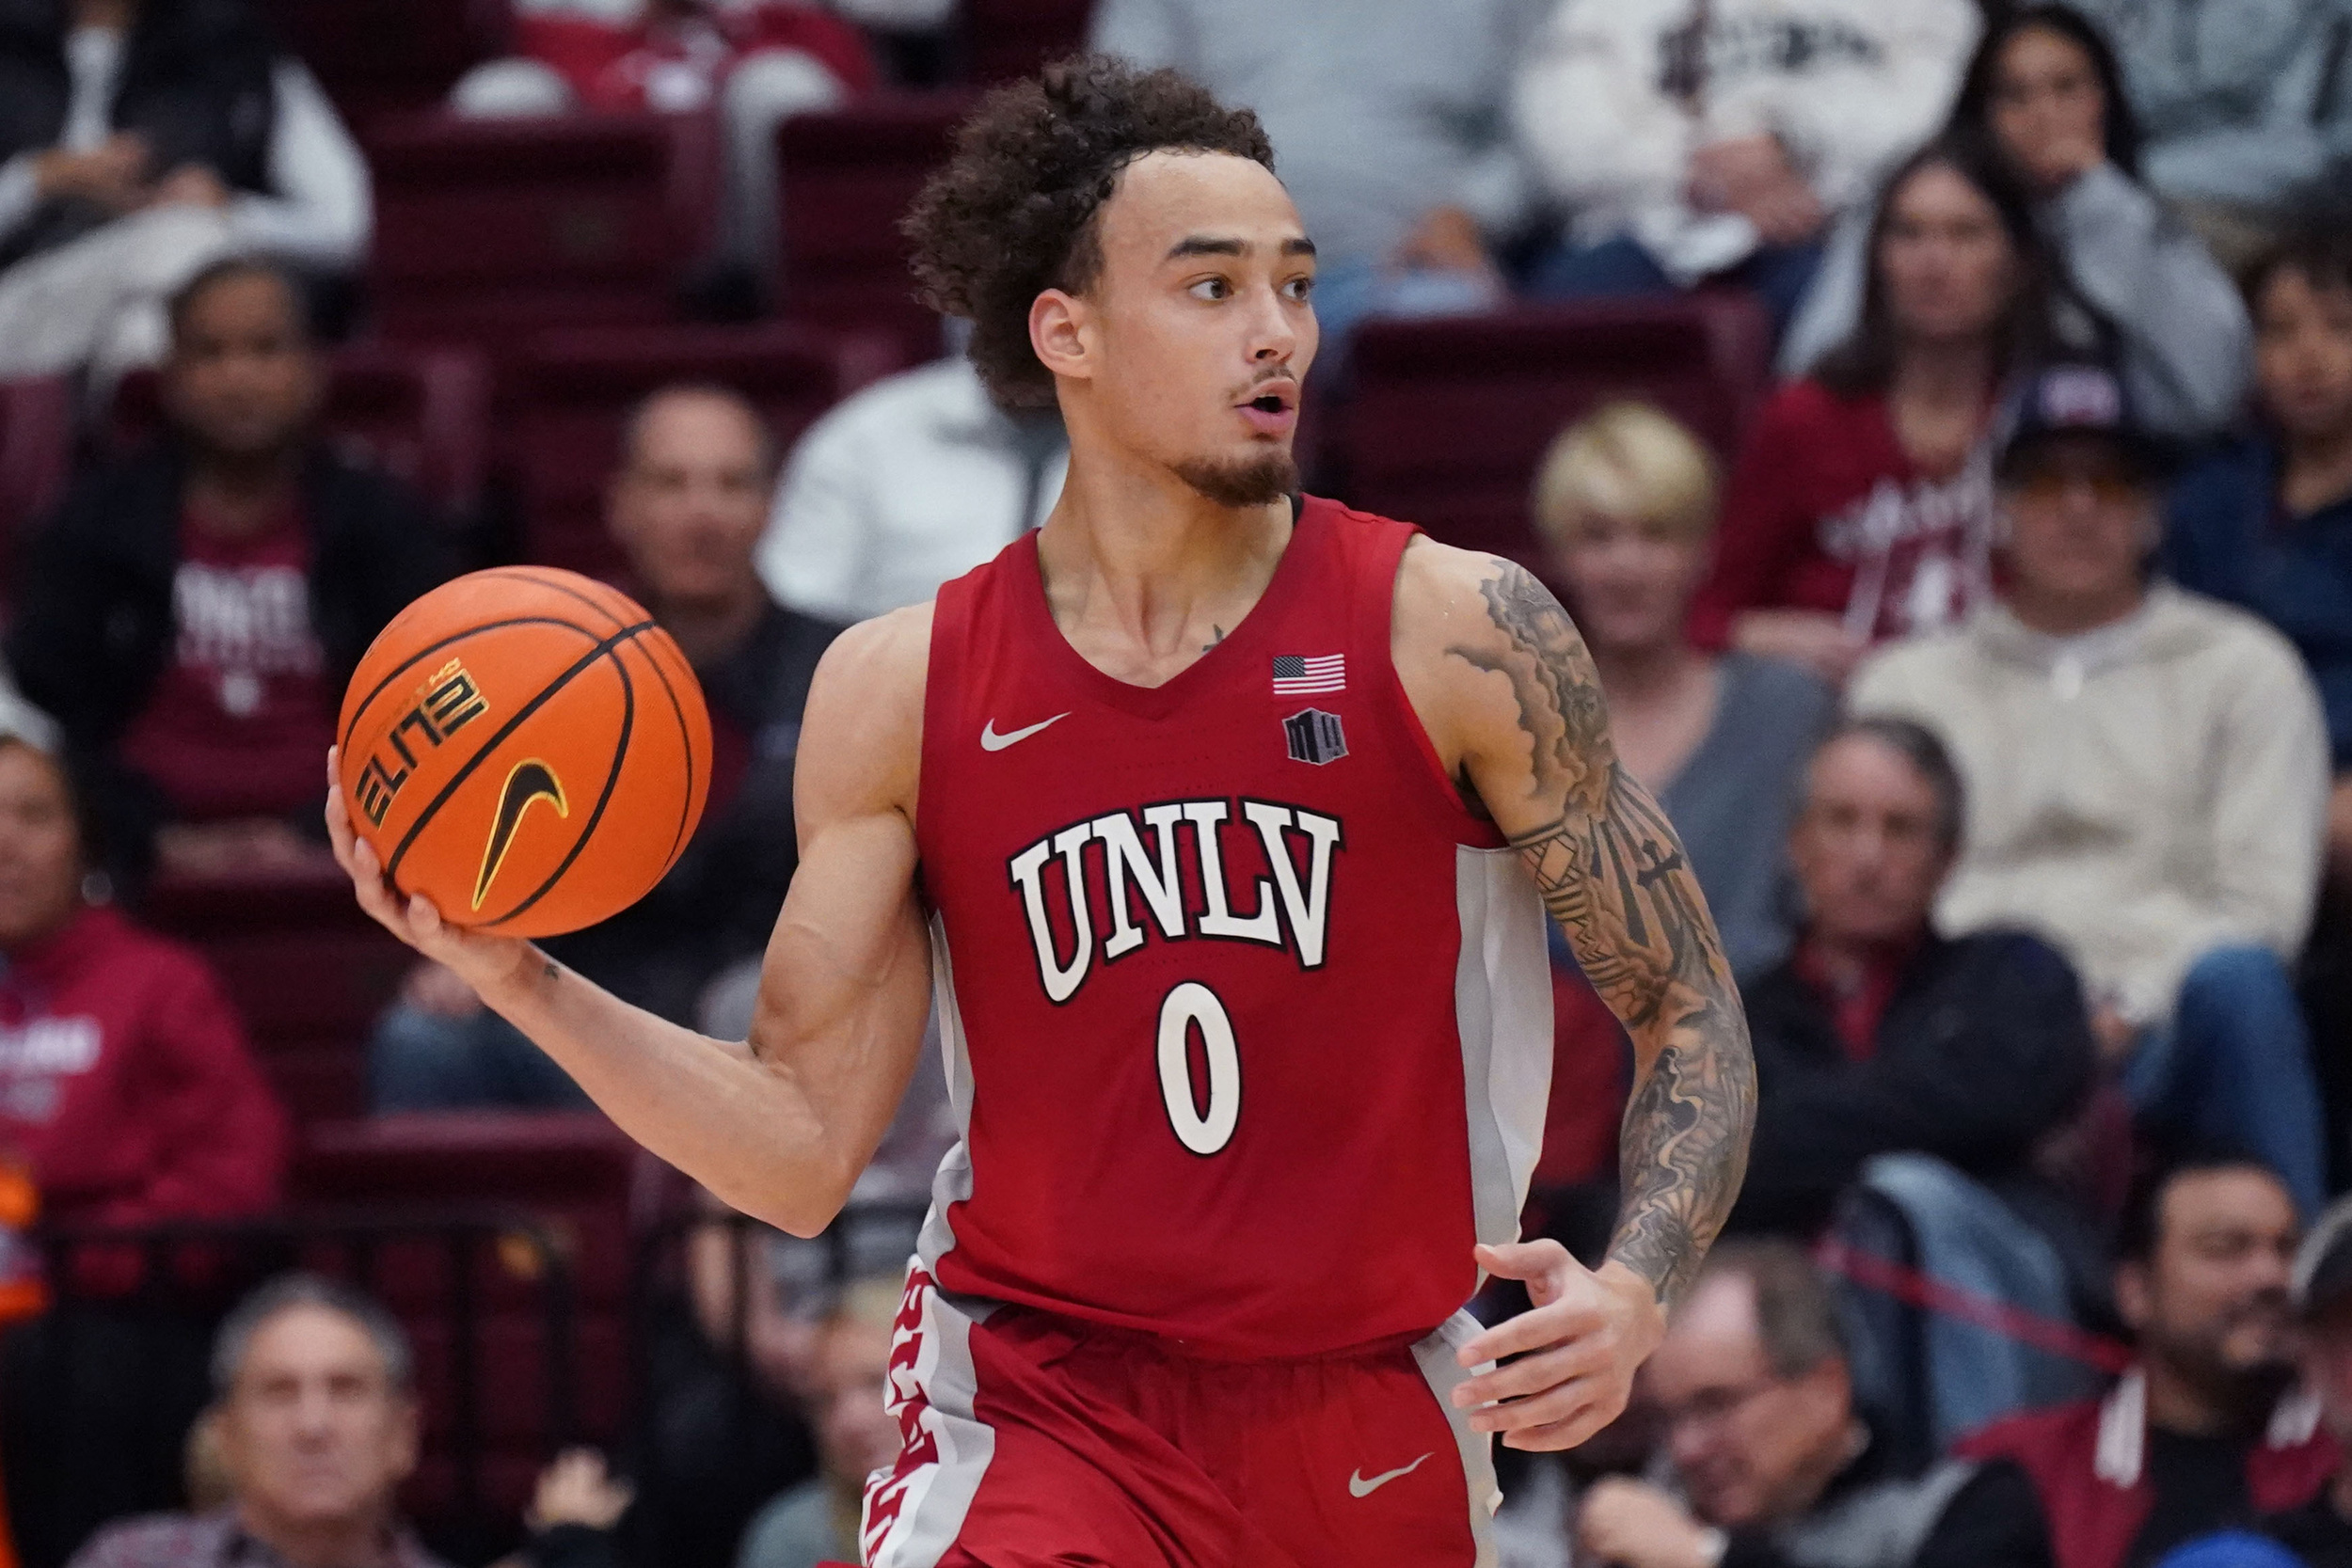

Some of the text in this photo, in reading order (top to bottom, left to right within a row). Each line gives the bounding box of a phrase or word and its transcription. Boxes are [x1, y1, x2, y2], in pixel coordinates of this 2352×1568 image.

[354, 668, 490, 832] ELITE
[1008, 799, 1343, 1005] UNLV
[1156, 981, 1242, 1156] 0
